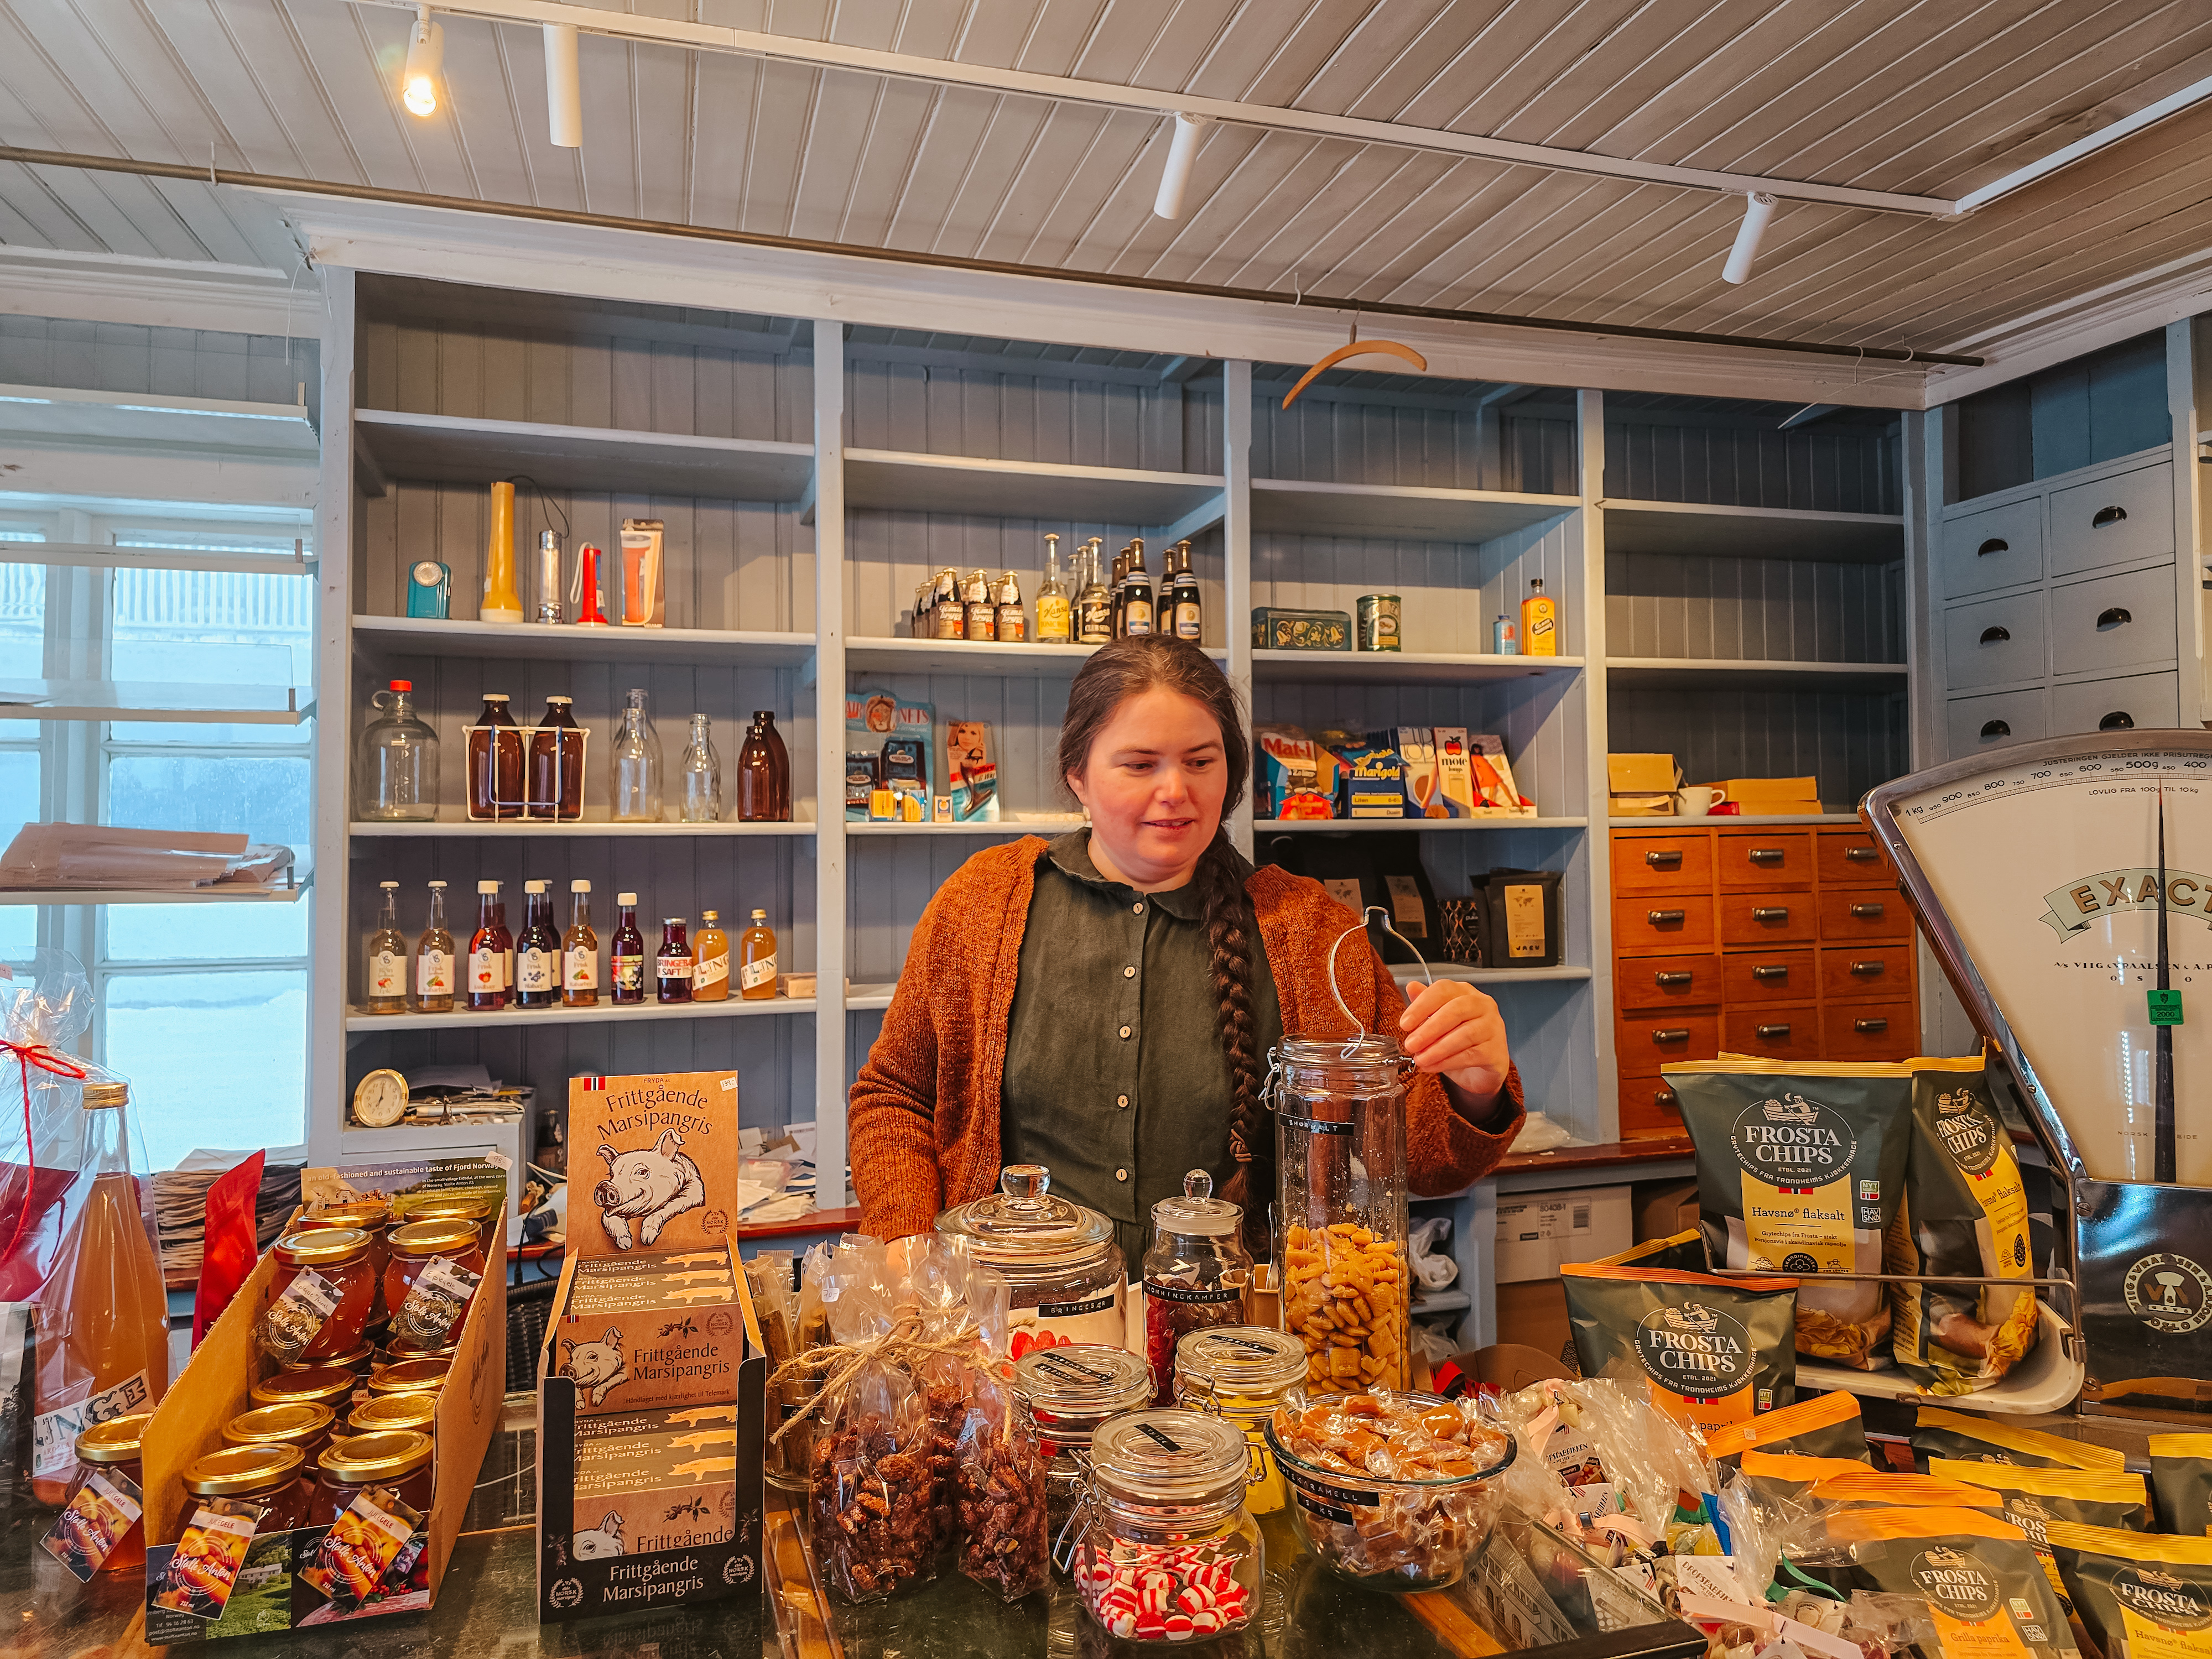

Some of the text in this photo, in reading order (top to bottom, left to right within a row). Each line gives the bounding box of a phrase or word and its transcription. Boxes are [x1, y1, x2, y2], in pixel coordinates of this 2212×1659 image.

[846, 701, 930, 724] AIR NETS
[2043, 755, 2098, 766] JUSTERINGEN
[2079, 764, 2102, 772] 600
[2126, 760, 2158, 769] 500g
[1354, 765, 1401, 780] Marigold
[2031, 770, 2052, 779] 700
[1984, 780, 2005, 790] 800
[2089, 787, 2117, 796] LOVLIG
[1942, 791, 1963, 803] 900
[606, 1084, 708, 1113] Frittgående
[597, 1109, 713, 1141] Marsipangris
[1936, 1114, 1985, 1138] FROSTA
[1744, 1125, 1843, 1146] FROSTA
[1946, 1126, 1987, 1154] CHIPS
[1730, 1135, 1824, 1185] GRYTECHIPS FRA TRONDHEIMS
[1755, 1145, 1833, 1164] CHIPS
[318, 1171, 368, 1180] old-fashioned
[384, 1166, 424, 1176] sustainable
[453, 1163, 471, 1172] Fjord
[1802, 1207, 1845, 1220] flaksalt
[1754, 1237, 1784, 1246] porsjonsvis
[1788, 1239, 1824, 1247] skandinavisk
[1762, 1230, 1792, 1239] Grytechips
[577, 1260, 647, 1269] Frittgående
[577, 1264, 657, 1274] Marsipangris
[574, 1276, 646, 1286] Frittgående
[574, 1281, 657, 1291] Marsipangris
[571, 1294, 646, 1305] Frittgående
[1146, 1284, 1229, 1301] HONNINGKAMFER
[570, 1299, 657, 1310] Marsipangris
[404, 1300, 428, 1317] Stolte
[425, 1312, 451, 1330] Anton
[268, 1310, 290, 1328] Stolte
[285, 1326, 310, 1345] Anton
[1648, 1329, 1743, 1354] FROSTA
[633, 1342, 719, 1366] Frittgående
[1659, 1350, 1737, 1373] CHIPS
[633, 1359, 730, 1382] Marsipangris
[1634, 1339, 1728, 1394] GRYTECHIPS FRA TRONDHEIMS
[626, 1396, 654, 1404] Håndlaget
[655, 1394, 668, 1402] med
[669, 1391, 697, 1401] kjærlighet
[705, 1389, 730, 1397] Telemark
[574, 1469, 650, 1483] rittgående
[103, 1486, 126, 1507] JULEGELE
[207, 1518, 235, 1529] JULEGELE
[368, 1509, 394, 1529] JULEGELE
[64, 1509, 87, 1530] Stolte
[82, 1528, 109, 1552] Anton
[324, 1536, 352, 1558] Stolte
[346, 1554, 377, 1578] Anton
[171, 1553, 232, 1581] Stolte Anton
[610, 1555, 699, 1582] Frittgående
[1918, 1569, 1990, 1586] FROSTA
[602, 1575, 705, 1603] Marsipangris
[1935, 1584, 1987, 1601] CHIPS
[2120, 1582, 2202, 1613] FROSTA
[2131, 1598, 2198, 1617] CHIPS
[1950, 1632, 2010, 1645] Grilla paprika
[2180, 1640, 2212, 1656] flaksal
